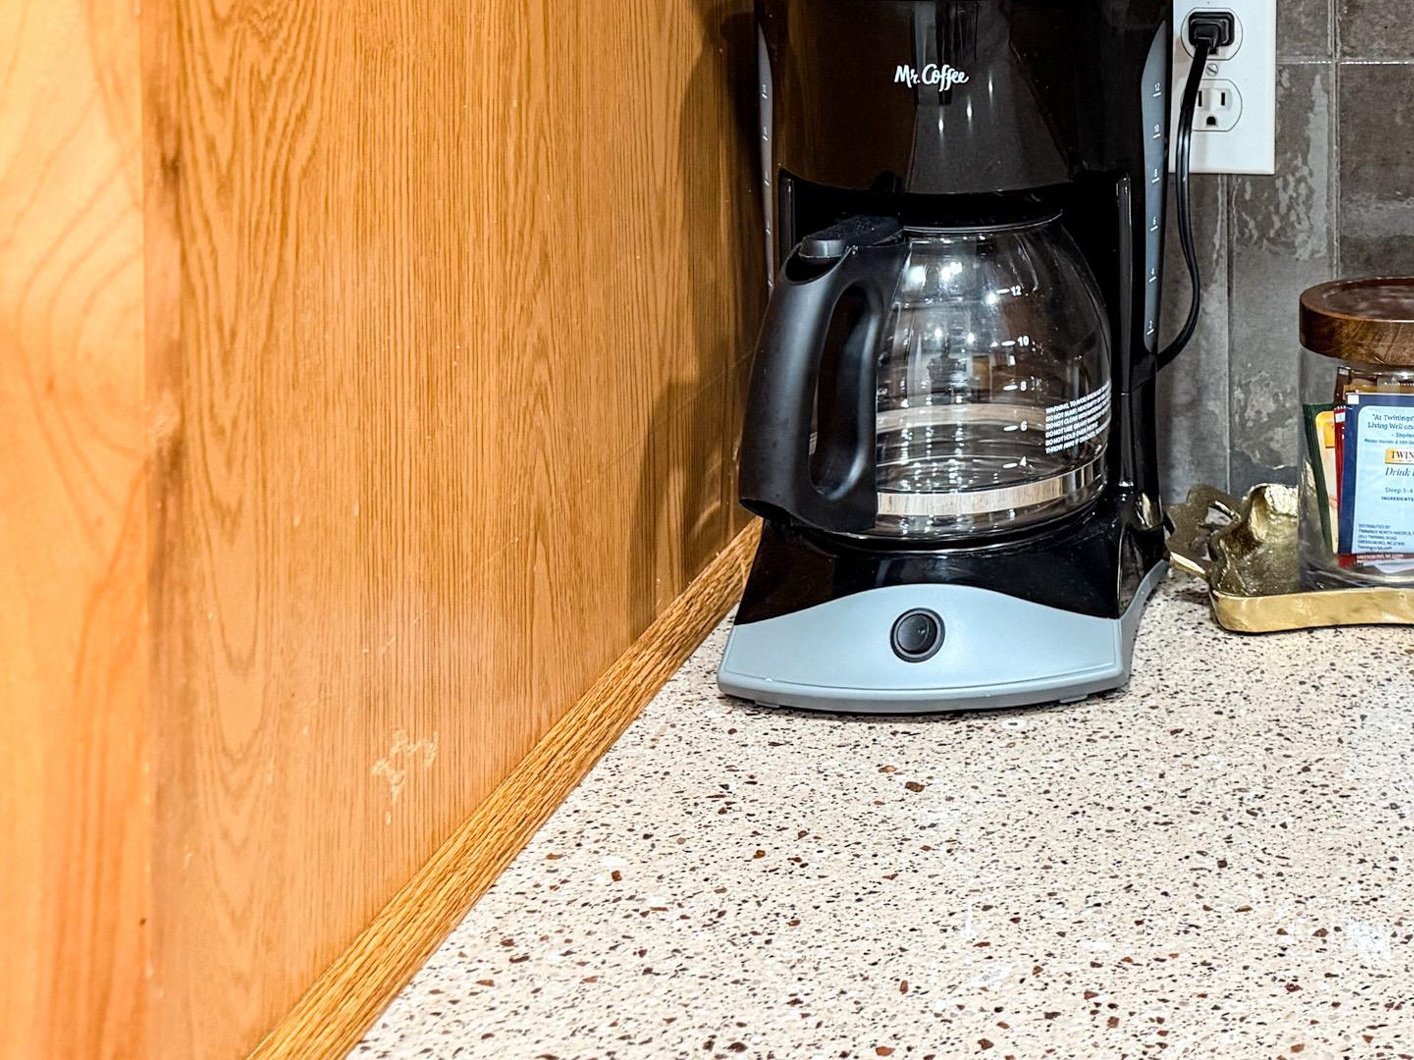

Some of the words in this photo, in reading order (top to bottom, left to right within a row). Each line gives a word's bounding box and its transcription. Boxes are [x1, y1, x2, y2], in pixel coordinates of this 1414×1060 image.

[894, 65, 921, 88] Mr.
[922, 64, 969, 92] Coffee
[1011, 285, 1022, 296] 12
[1018, 336, 1030, 347] 10
[1020, 381, 1027, 391] 8
[1020, 421, 1028, 431] 6
[1367, 422, 1388, 430] Living
[1389, 422, 1403, 430] Well
[1020, 456, 1027, 467] 4
[1385, 467, 1411, 477] Drink
